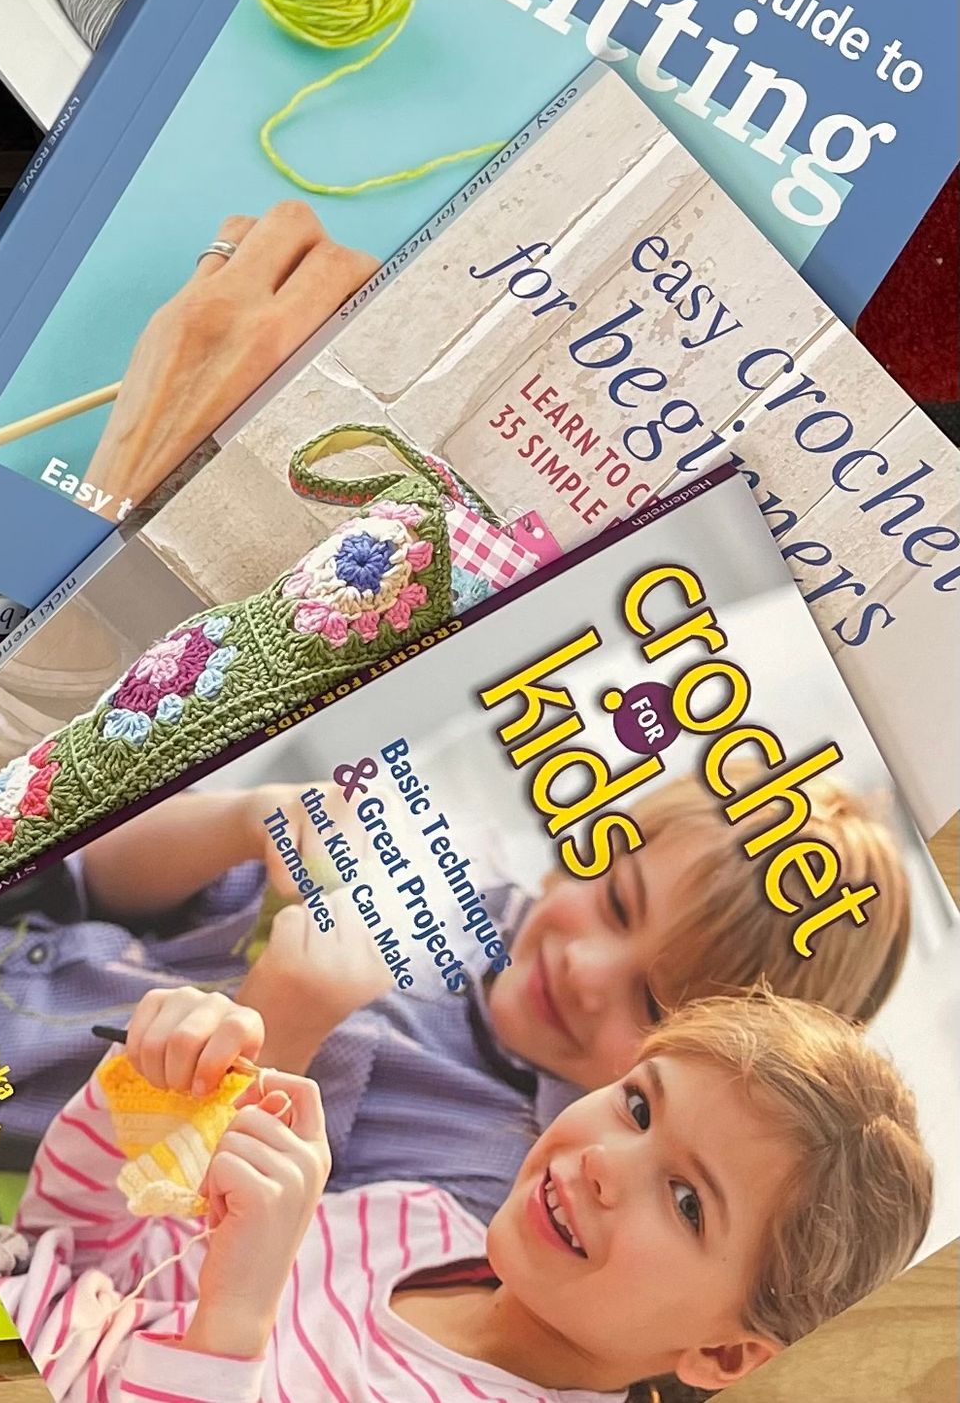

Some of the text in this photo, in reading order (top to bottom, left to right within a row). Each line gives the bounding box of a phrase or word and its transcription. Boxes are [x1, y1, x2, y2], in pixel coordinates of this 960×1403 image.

[48, 96, 80, 145] LYNNE
[875, 36, 925, 96] to
[461, 132, 530, 203] crochet
[469, 241, 577, 318] for
[631, 235, 744, 349] easy
[40, 457, 113, 513] Easy
[489, 404, 608, 525] 35 SIMPLE
[520, 374, 631, 487] LEARN TO
[264, 620, 463, 737] CROCHET FOR KIDS
[629, 695, 665, 744] FOR
[478, 625, 665, 881] kids
[621, 563, 881, 961] crochet
[263, 807, 336, 933] Themselves
[300, 787, 415, 990] that Kids Can Make
[333, 757, 467, 991] & Great Projects
[380, 738, 512, 973] Basic Techniques
